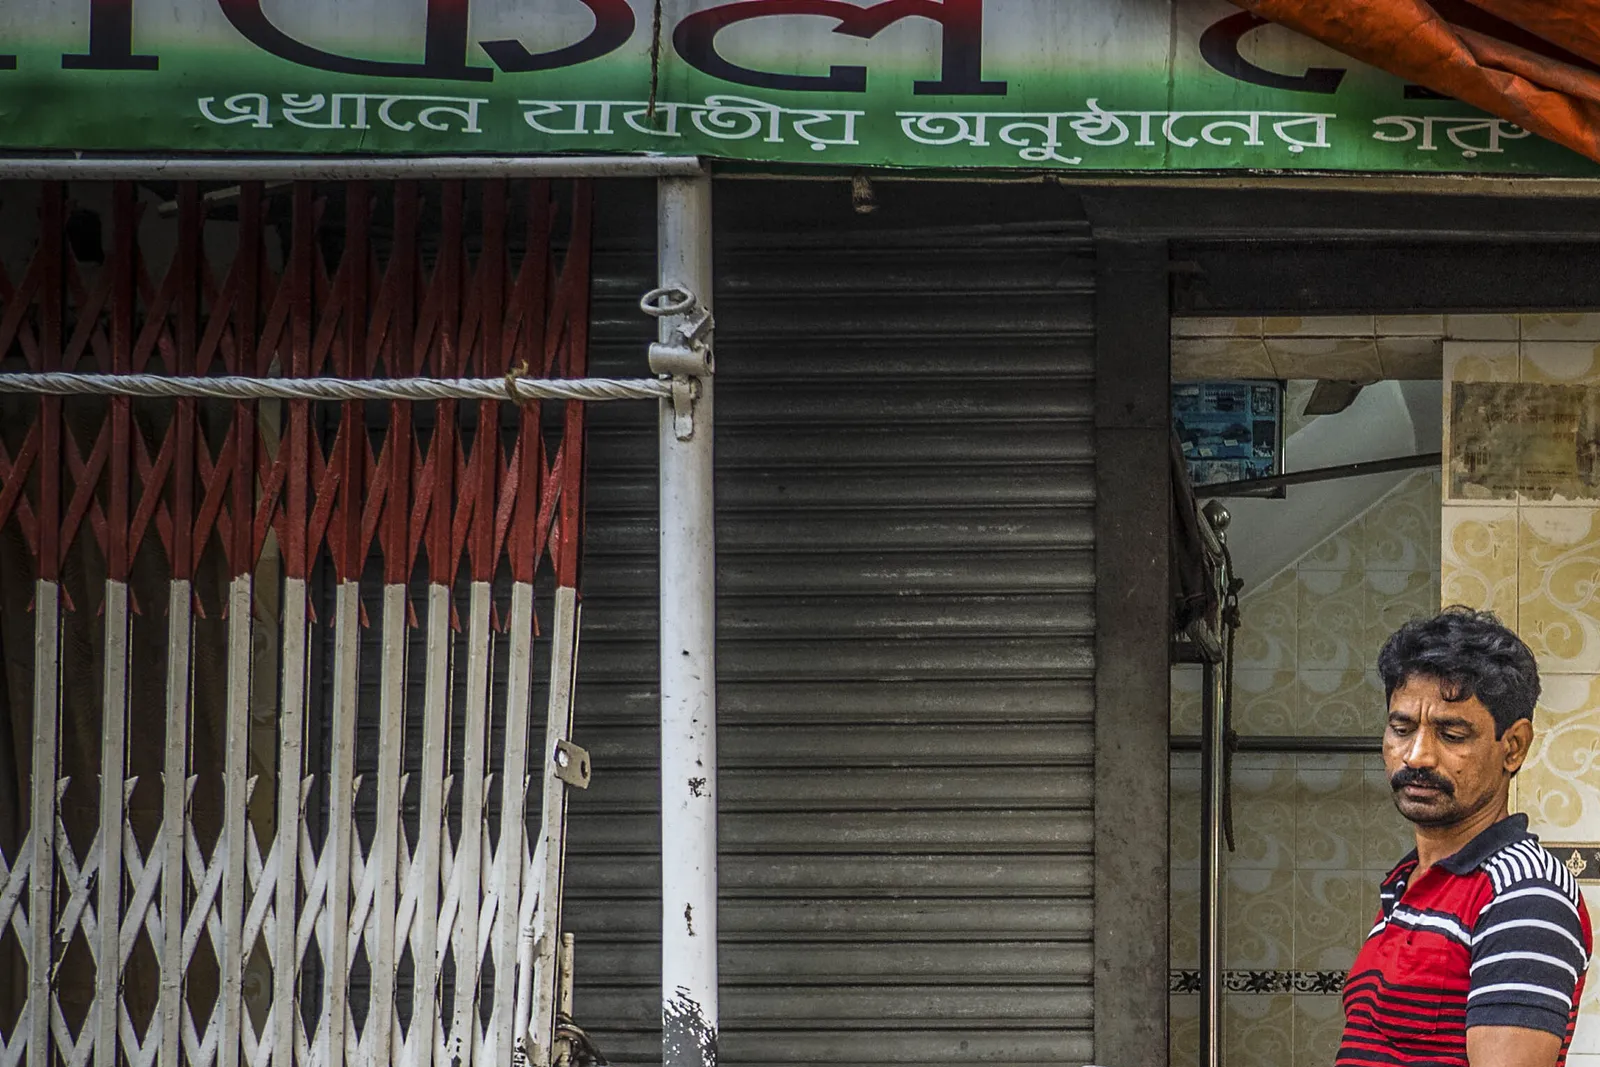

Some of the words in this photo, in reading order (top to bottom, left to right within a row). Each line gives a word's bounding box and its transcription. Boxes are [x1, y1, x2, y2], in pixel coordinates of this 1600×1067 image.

[198, 92, 489, 134] এখানে
[518, 95, 866, 151] যাবতীয়
[895, 98, 1338, 165] অনুষ্ঠানের
